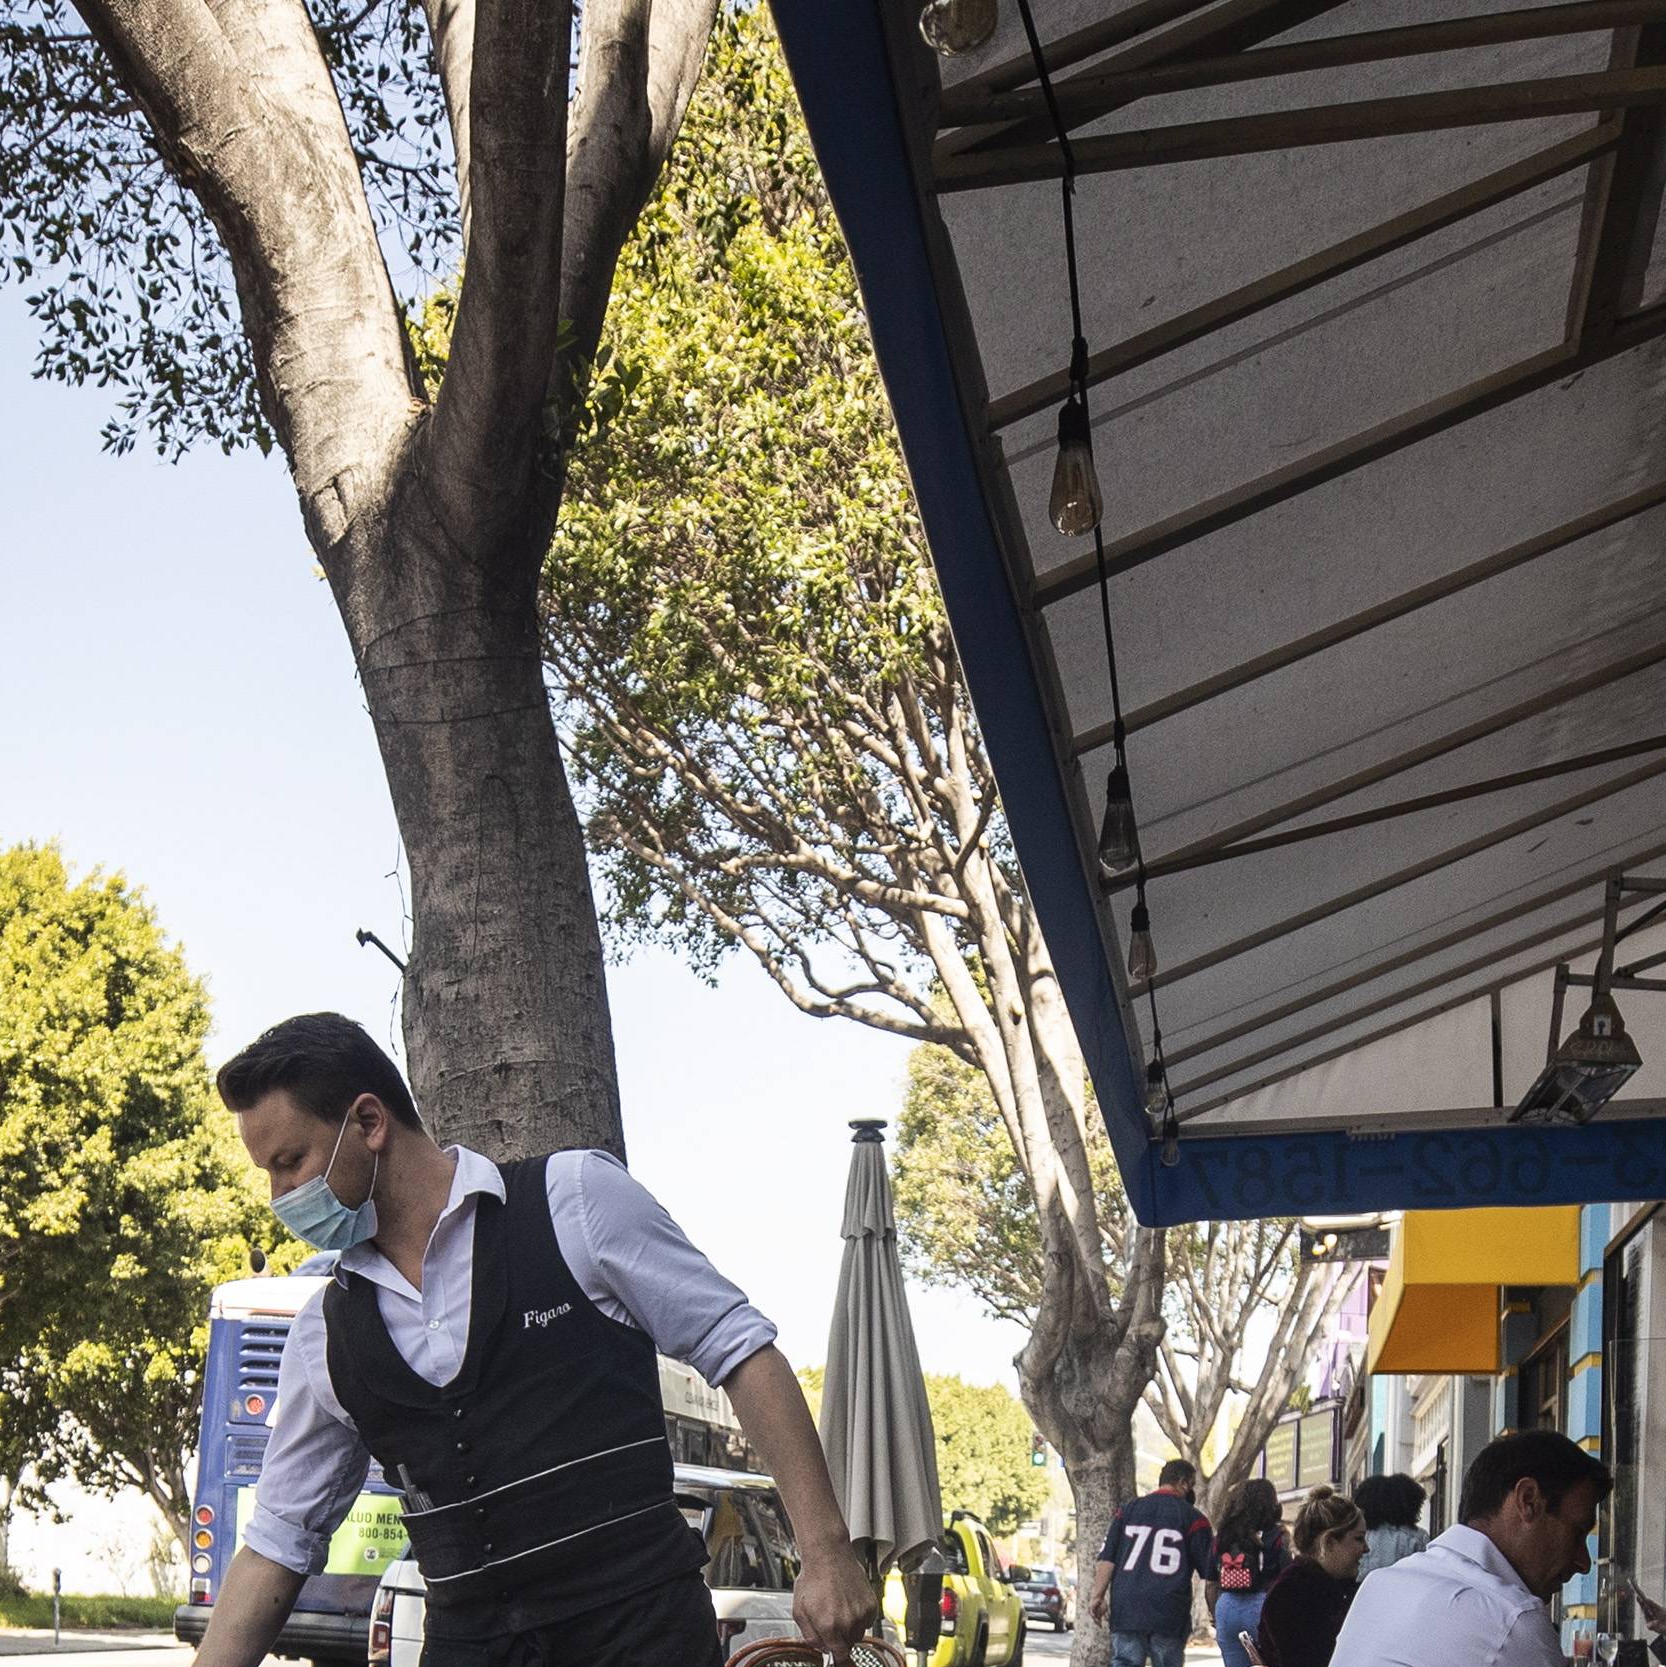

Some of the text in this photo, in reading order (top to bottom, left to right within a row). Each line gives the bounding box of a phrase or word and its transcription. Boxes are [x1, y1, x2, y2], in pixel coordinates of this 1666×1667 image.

[523, 1302, 573, 1329] Figaro
[376, 1513, 400, 1525] MEN
[1122, 1524, 1183, 1576] 76
